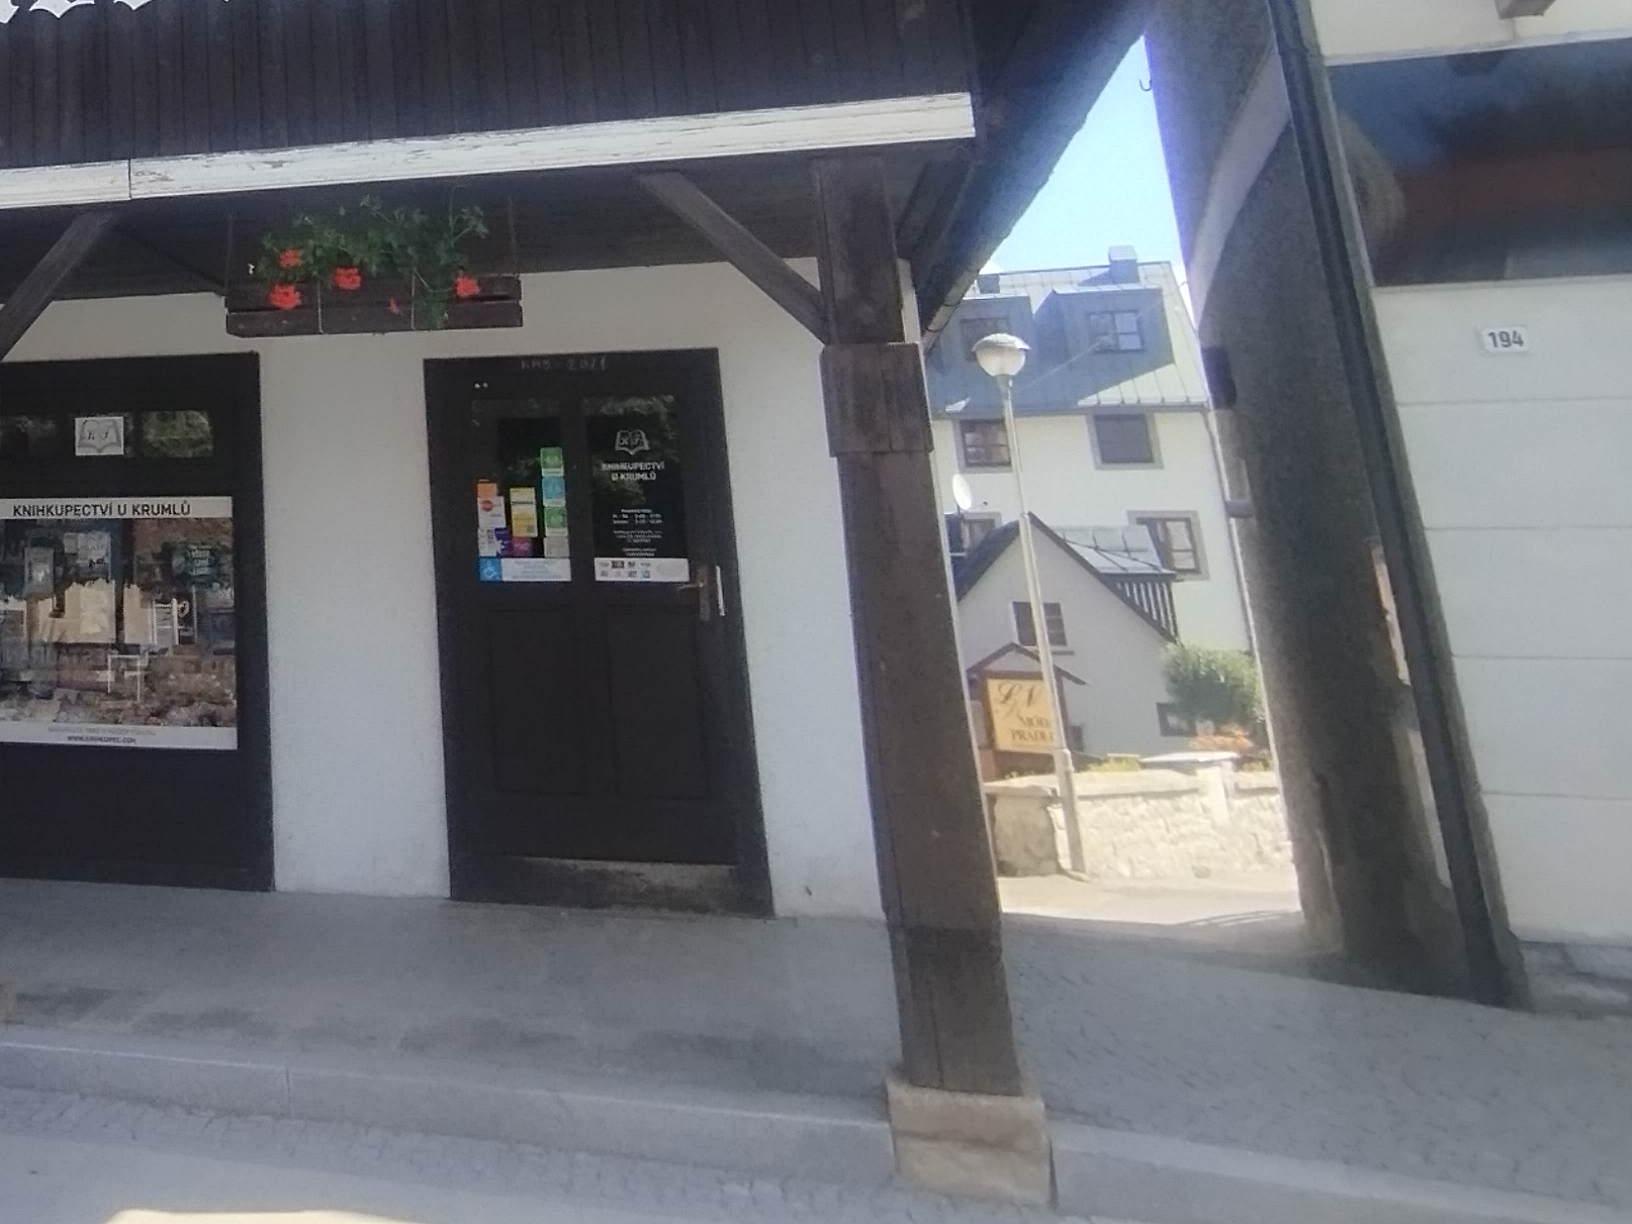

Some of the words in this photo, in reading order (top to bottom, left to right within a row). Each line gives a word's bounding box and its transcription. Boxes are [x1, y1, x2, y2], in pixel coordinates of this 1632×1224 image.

[1487, 329, 1525, 349] 194
[13, 502, 112, 517] KNIHKUPECTVÍ
[118, 504, 127, 516] U
[132, 501, 191, 516] KRUMLŮ
